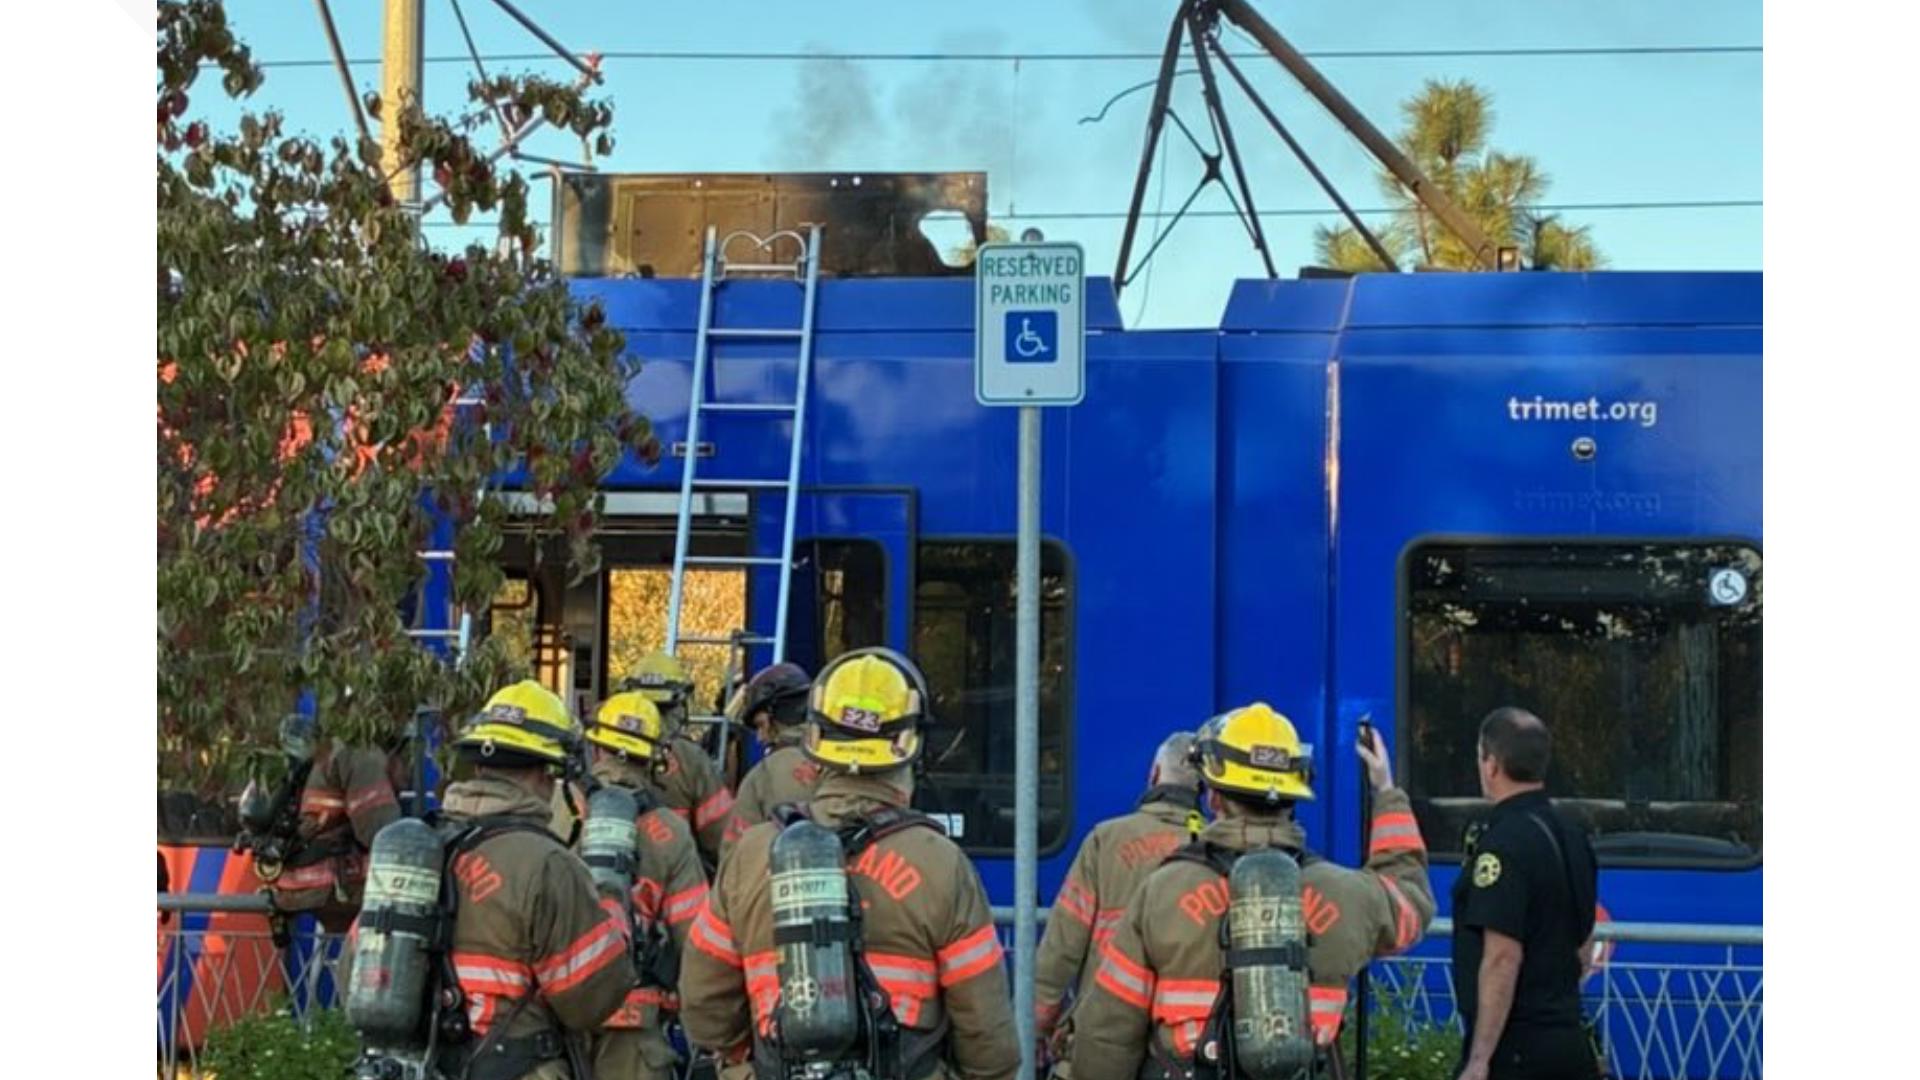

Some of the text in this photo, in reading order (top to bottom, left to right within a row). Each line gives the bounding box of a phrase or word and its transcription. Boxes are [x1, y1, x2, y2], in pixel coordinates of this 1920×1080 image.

[984, 256, 1078, 277] RESERVED
[991, 284, 1072, 304] PARKING
[1507, 396, 1657, 427] trimet.org
[842, 705, 880, 730] E23
